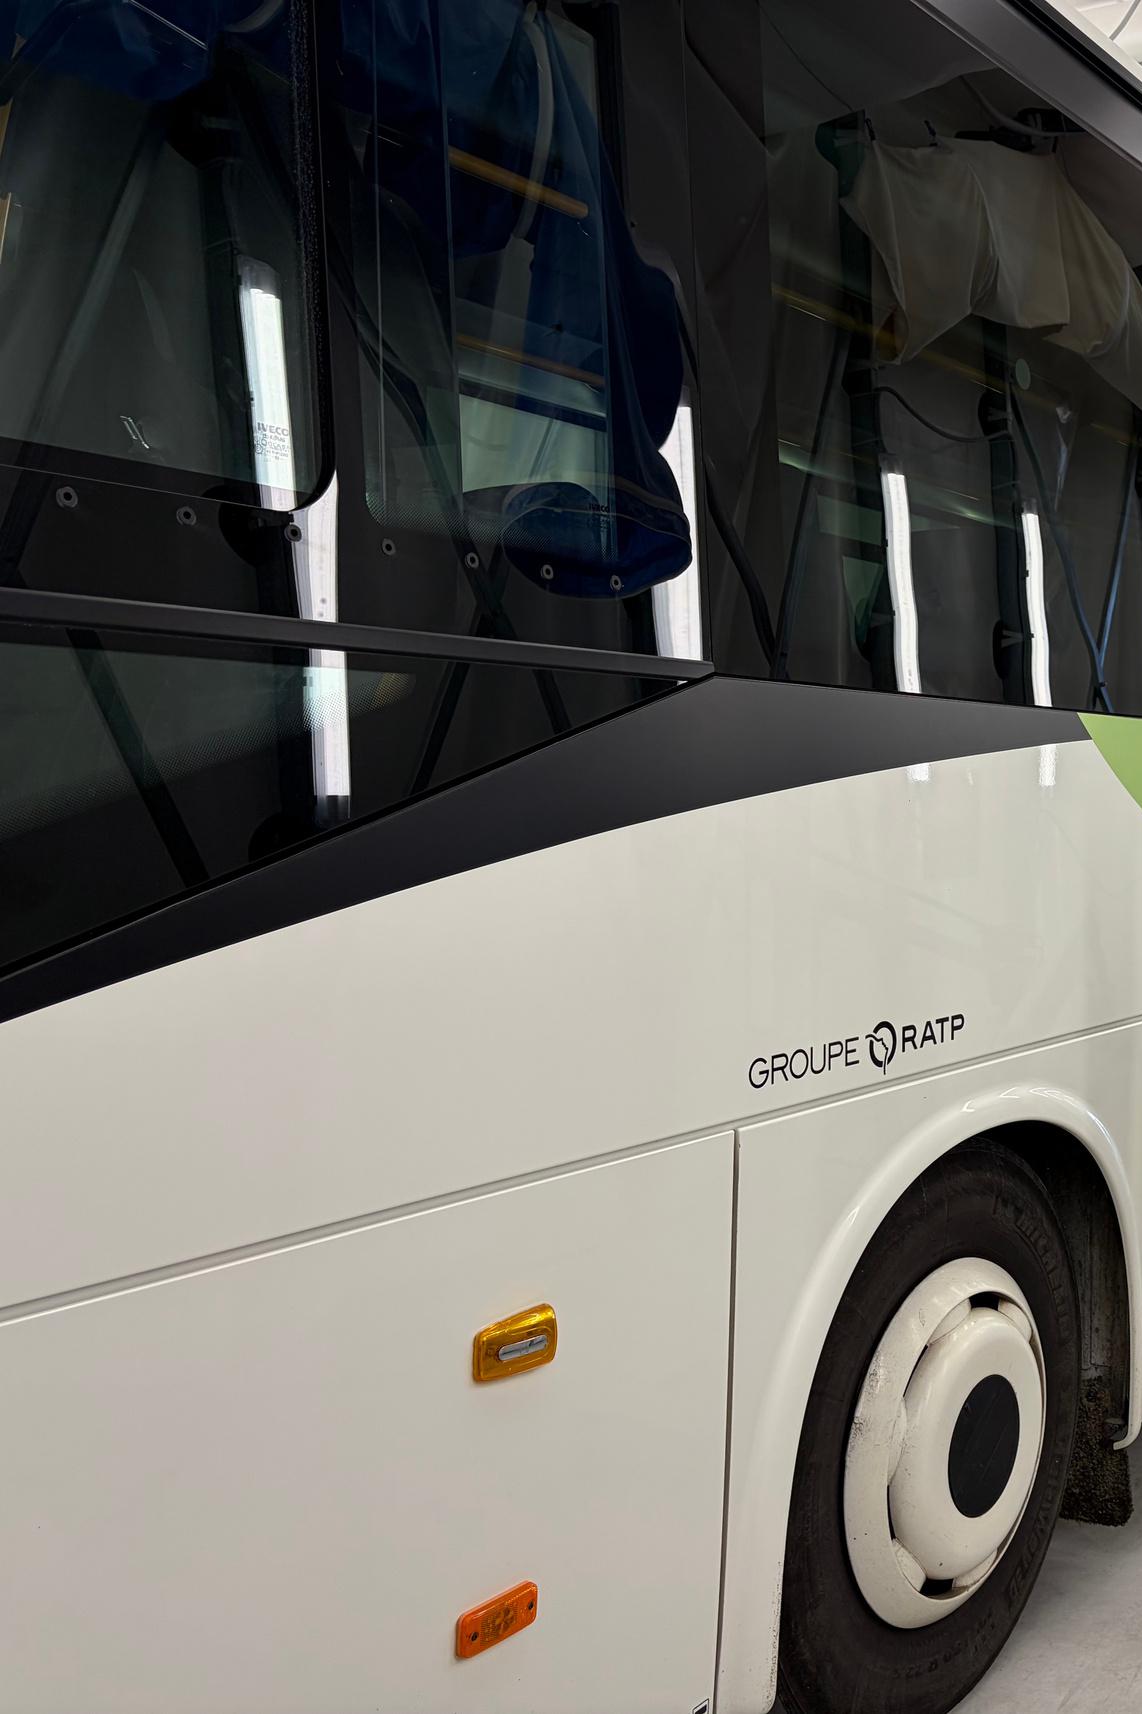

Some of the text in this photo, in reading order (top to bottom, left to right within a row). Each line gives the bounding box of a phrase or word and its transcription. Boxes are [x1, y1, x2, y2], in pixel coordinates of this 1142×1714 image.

[257, 422, 289, 436] IVECO
[748, 1013, 965, 1089] GROUPE RATP
